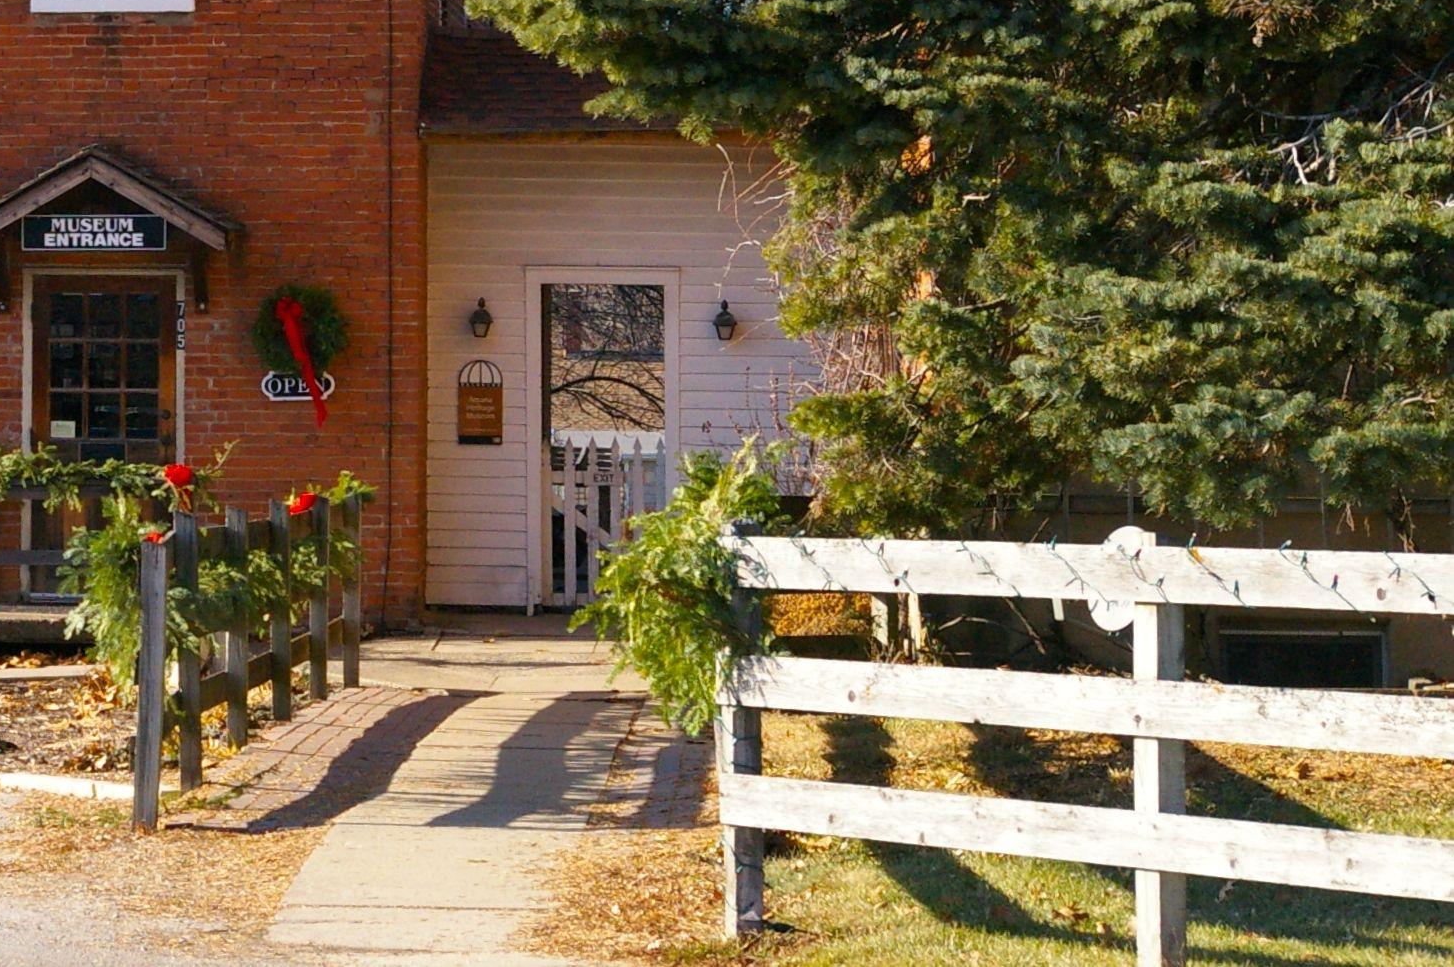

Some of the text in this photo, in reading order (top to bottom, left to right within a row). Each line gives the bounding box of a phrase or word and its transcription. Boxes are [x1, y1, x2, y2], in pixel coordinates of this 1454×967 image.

[51, 218, 134, 232] MUSEUM
[44, 233, 144, 247] ENTRANCE
[176, 302, 186, 348] 705
[267, 377, 325, 394] OPEN
[593, 474, 615, 483] EXIT
